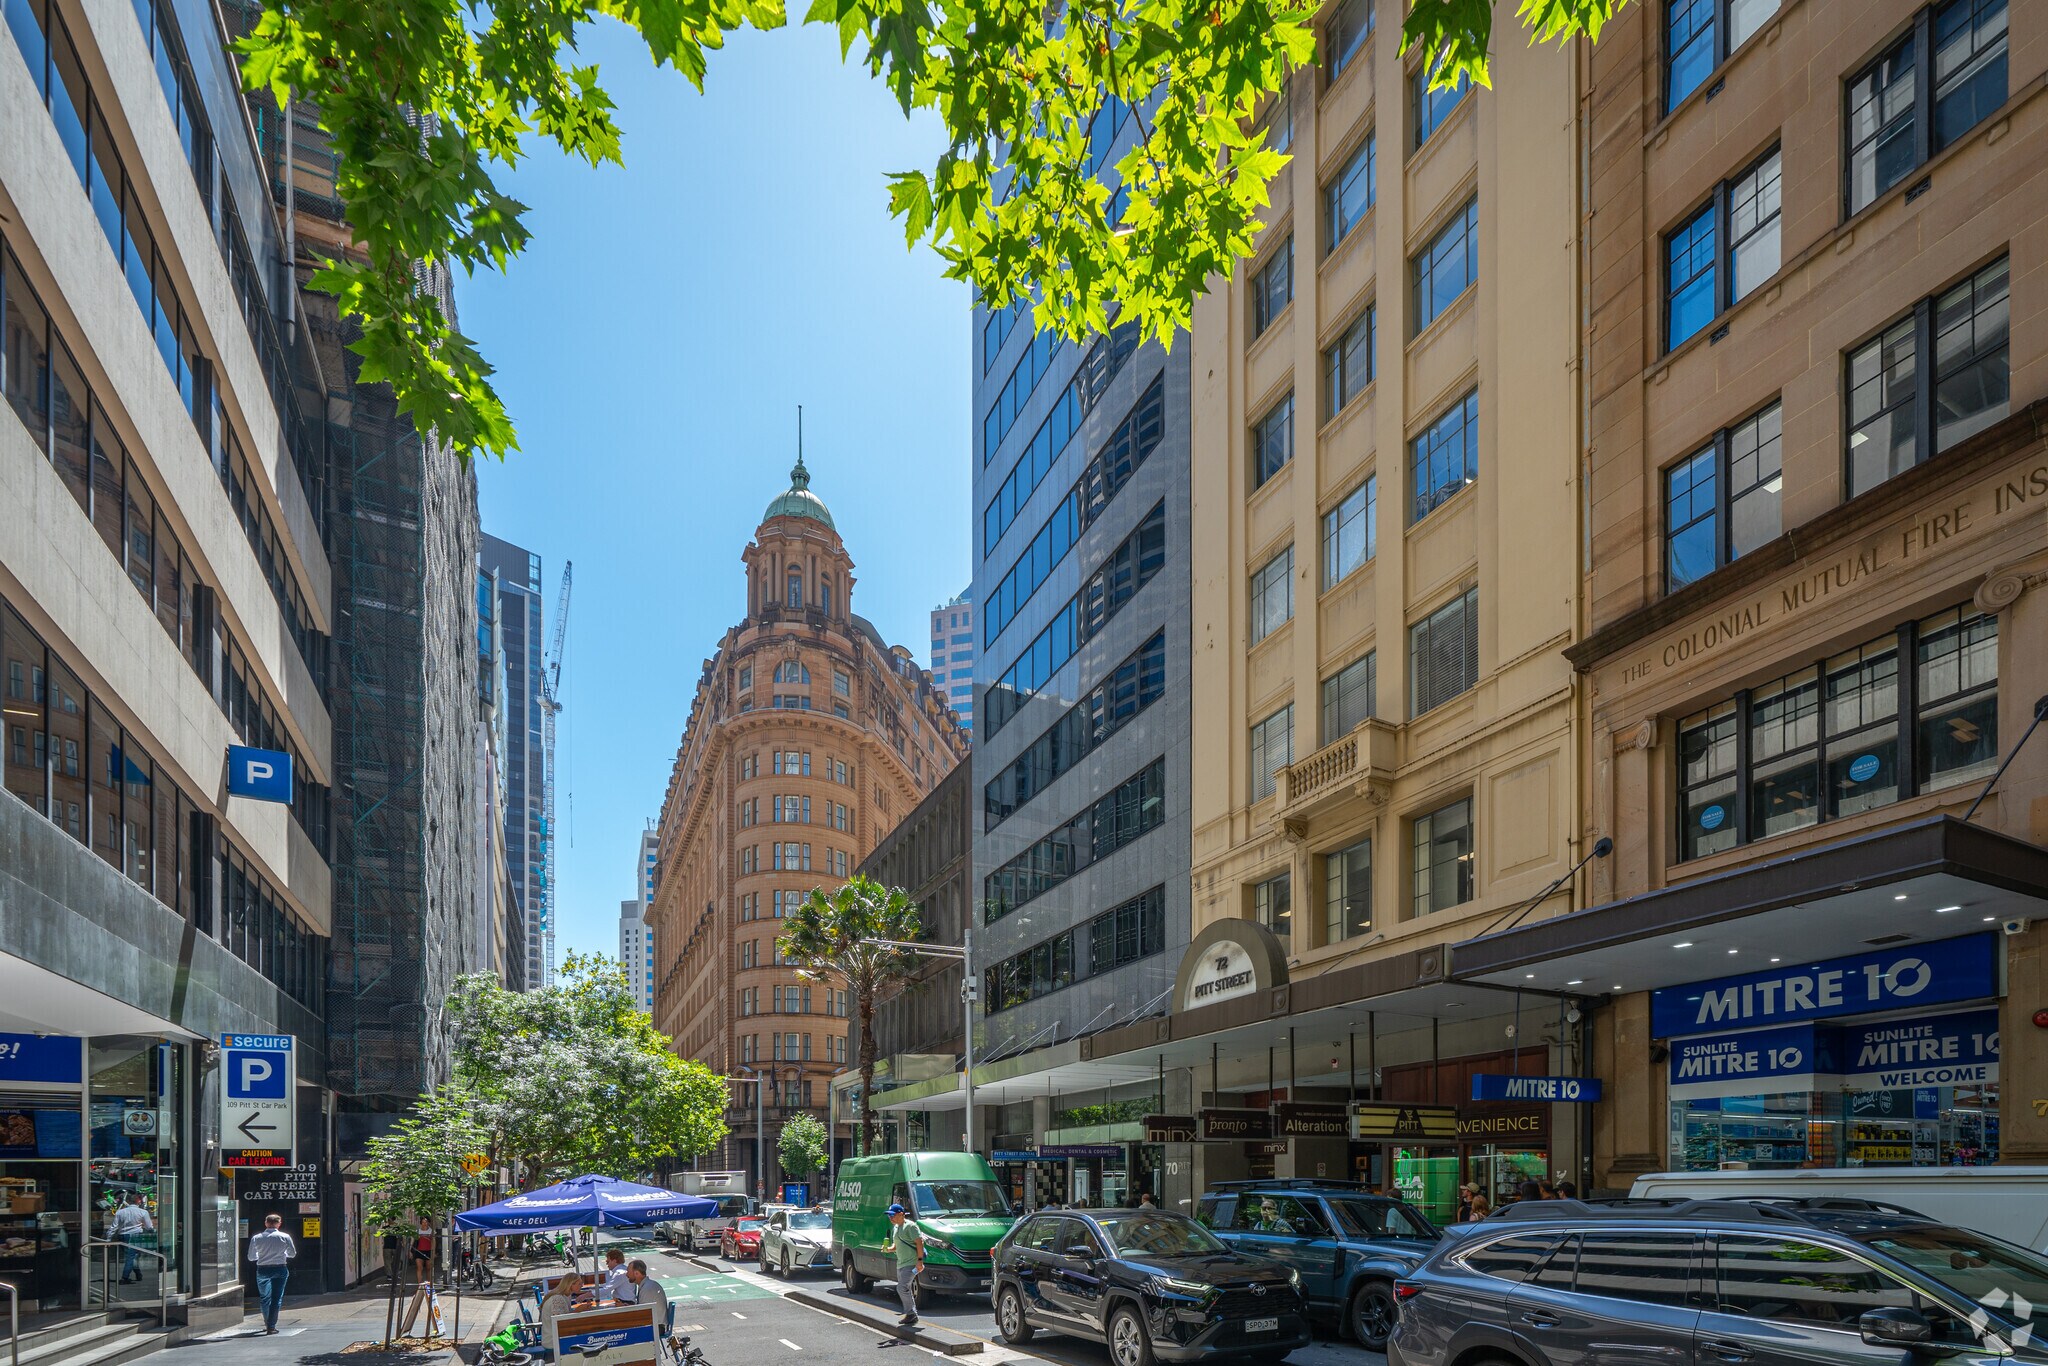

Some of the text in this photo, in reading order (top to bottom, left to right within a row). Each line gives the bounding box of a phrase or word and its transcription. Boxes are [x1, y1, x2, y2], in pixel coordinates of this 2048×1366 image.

[1621, 658, 1652, 684] THE
[1663, 601, 1770, 668] COLONIAL
[1782, 547, 1888, 615] MUTUAL
[1902, 502, 1973, 558] FIRE
[246, 760, 274, 784] P
[1214, 956, 1229, 971] 72
[1194, 970, 1252, 998] PITT STREET
[1695, 957, 1932, 1025] MITRE 10
[1863, 1025, 1933, 1043] SUNLITE
[234, 1036, 289, 1048] secure
[1683, 1041, 1738, 1057] SUNLITE
[1857, 1036, 1959, 1067] MITRE
[1678, 1047, 1803, 1078] MITRE 10
[241, 1057, 273, 1092] P
[1880, 1066, 1986, 1087] WELCOME
[1505, 1078, 1581, 1099] MITRE 10
[1209, 1119, 1248, 1133] pronto
[1285, 1119, 1342, 1132] Alteration
[1399, 1120, 1419, 1130] PITT
[1149, 1126, 1198, 1142] minx
[241, 1149, 273, 1157] CAUTION
[1264, 1143, 1286, 1153] minx
[228, 1157, 286, 1166] CAR LEAVING
[1165, 1162, 1178, 1175] 70
[284, 1172, 317, 1181] PITT
[260, 1182, 317, 1191] STREET
[837, 1180, 862, 1198] ALSCO
[243, 1190, 317, 1200] CAR PARK
[835, 1199, 860, 1212] UNIFORMS
